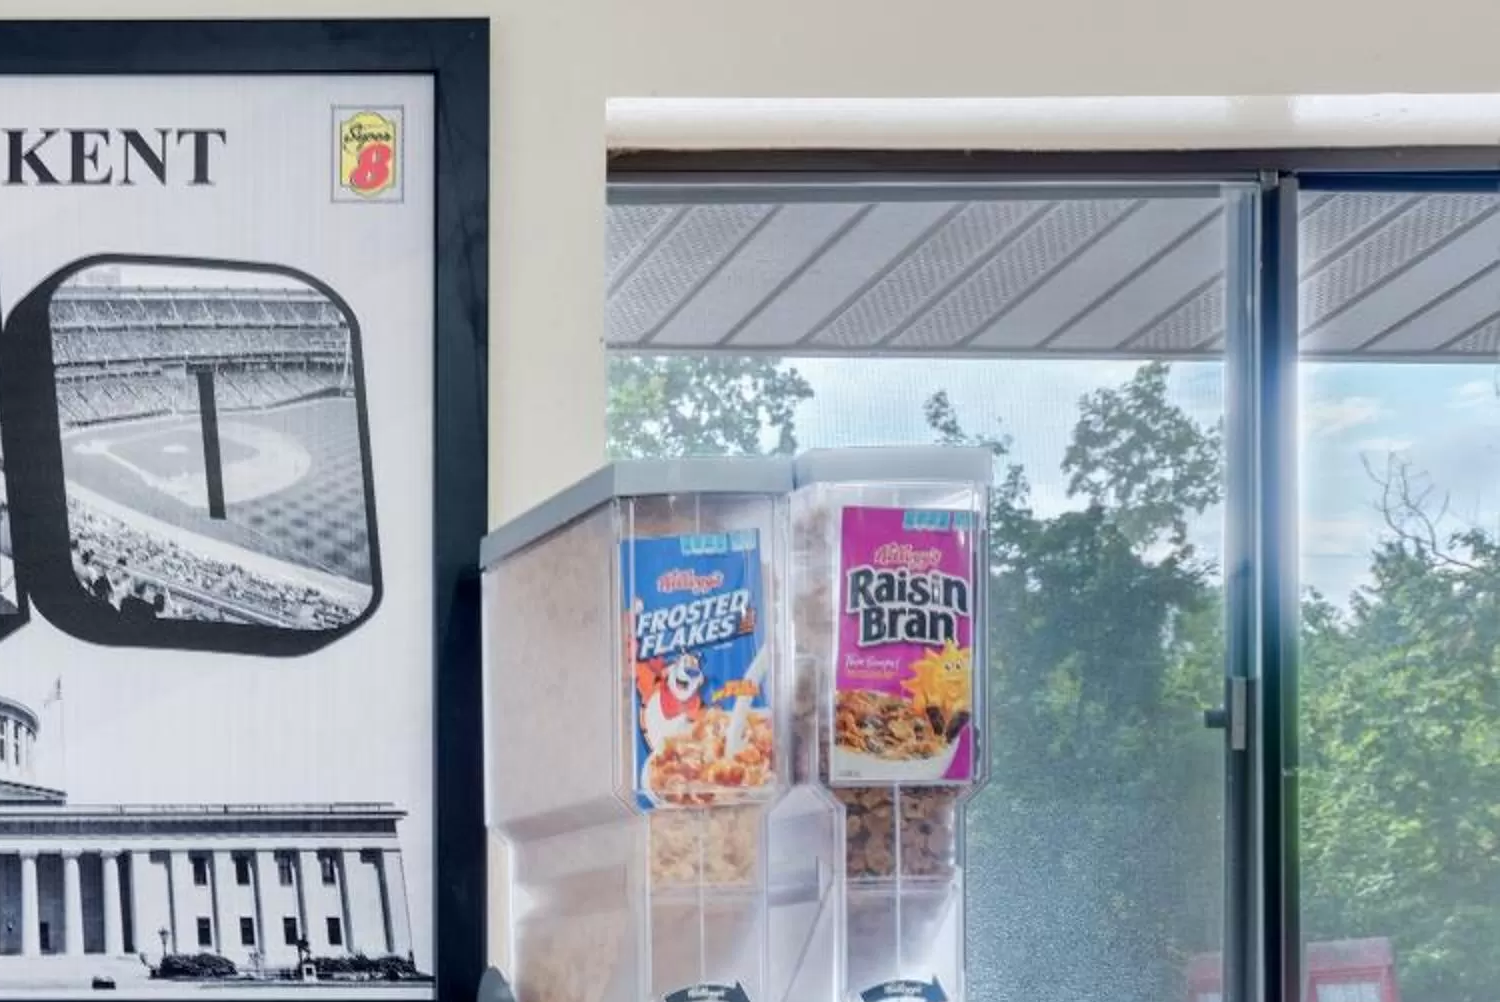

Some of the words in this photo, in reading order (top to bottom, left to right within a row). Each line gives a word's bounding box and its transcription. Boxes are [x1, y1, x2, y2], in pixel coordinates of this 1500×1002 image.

[1, 128, 227, 186] KENT
[348, 142, 392, 191] 8
[636, 588, 750, 638] FROSTED
[848, 566, 970, 614] Raisin
[638, 615, 736, 659] FLAKES
[860, 605, 956, 644] Bran
